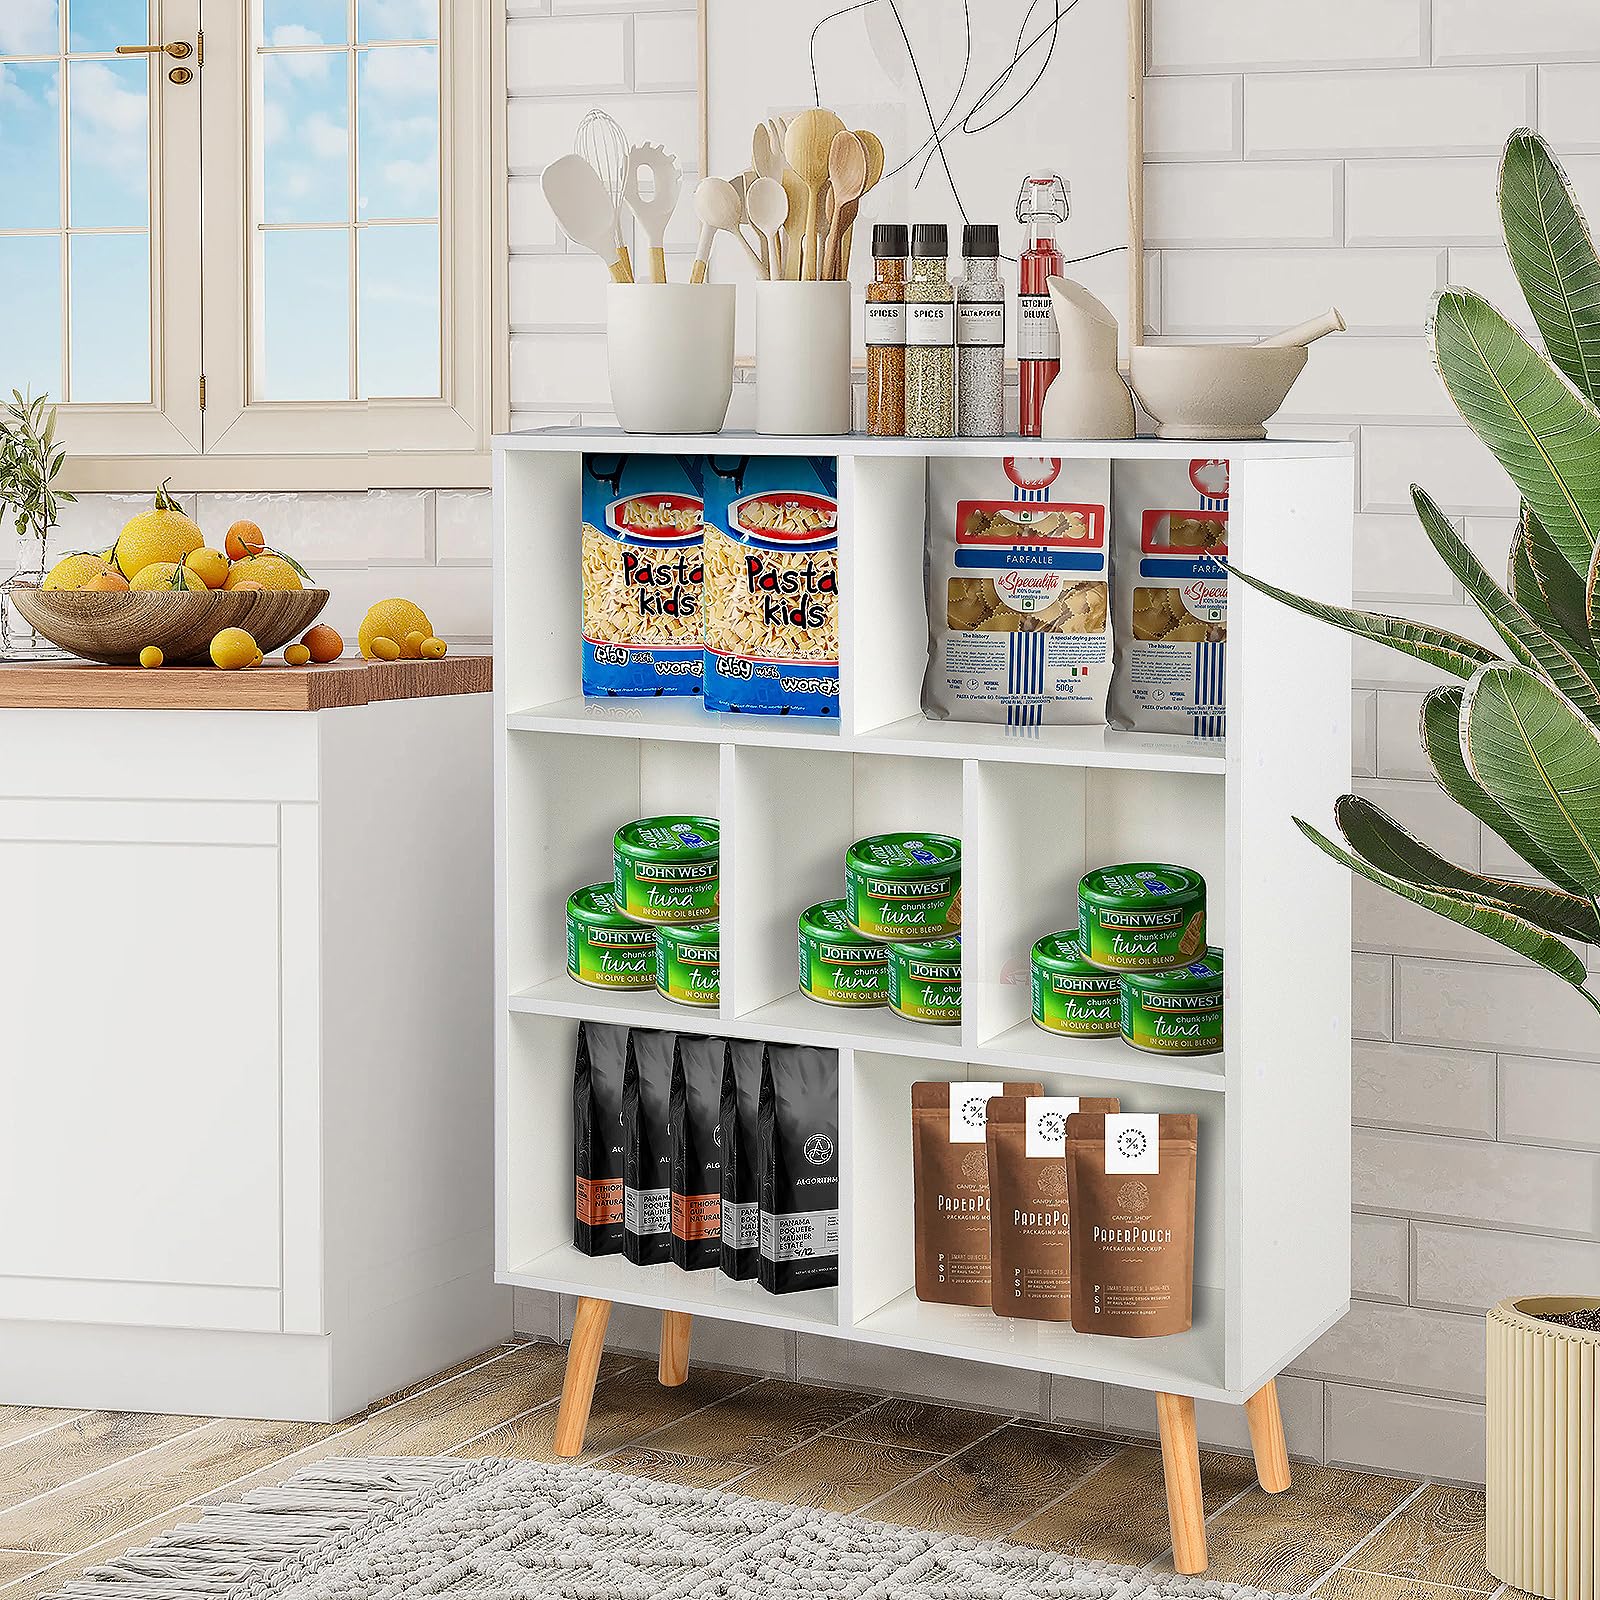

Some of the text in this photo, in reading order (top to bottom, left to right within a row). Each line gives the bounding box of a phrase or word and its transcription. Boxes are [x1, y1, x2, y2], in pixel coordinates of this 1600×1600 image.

[869, 309, 899, 318] SPICES
[913, 309, 944, 319] SPICES
[1023, 310, 1050, 319] DELUXE
[1006, 554, 1053, 565] FARFALLE
[744, 555, 839, 594] Pasta
[638, 586, 696, 617] kids
[763, 593, 826, 629] kids
[594, 644, 630, 667] play
[654, 660, 704, 678] word
[716, 655, 839, 697] play with words
[1055, 683, 1074, 693] 500g
[638, 863, 715, 879] JOHN WEST
[669, 885, 694, 894] chunk
[871, 881, 946, 896] JOHN WEST
[646, 886, 694, 907] tuna
[901, 901, 927, 911] chunk
[651, 909, 672, 918] OLIVE
[674, 909, 686, 918] OIL
[688, 907, 710, 917] BLEND
[878, 902, 926, 924] tuna
[1103, 911, 1178, 926] JOHN WEST
[884, 926, 904, 935] OLIVE
[906, 926, 918, 935] OIL
[920, 924, 943, 933] BLEND
[592, 930, 628, 943] JOHN
[1133, 931, 1158, 941] chunk
[1111, 933, 1159, 955] tuna
[621, 951, 647, 960] chunk
[825, 948, 861, 960] JOHN
[600, 950, 647, 973] tuna
[1116, 956, 1137, 964] OLIVE
[1139, 956, 1151, 965] OIL
[1152, 955, 1175, 964] BLEND
[854, 968, 879, 977] chunk
[913, 964, 950, 977] JOHN
[604, 974, 625, 983] OLIVE
[627, 975, 639, 983] OIL
[831, 967, 879, 989] tuna
[1056, 978, 1093, 991] JOHN
[694, 991, 714, 1000] OLIVE
[837, 991, 857, 1000] OLIVE
[859, 991, 871, 1000] OIL
[1086, 998, 1111, 1007] chunk
[1146, 994, 1221, 1008] JOHN WEST
[926, 1008, 946, 1017] OLIVE
[1065, 999, 1111, 1019] tuna
[1176, 1014, 1201, 1023] chunk
[1069, 1021, 1090, 1030] OLIVE
[1091, 1021, 1104, 1030] OIL
[1154, 1015, 1201, 1037] tuna
[1158, 1038, 1179, 1047] OLIVE
[1181, 1038, 1193, 1047] OIL
[1195, 1038, 1217, 1047] BLEND
[594, 1192, 611, 1200] GUJI
[689, 1208, 705, 1216] GUJI
[643, 1216, 667, 1224] ESTATE
[780, 1219, 811, 1228] PANAMA
[780, 1233, 813, 1242] MAUNIER
[1093, 1226, 1171, 1243] PAPERPOUCH
[780, 1241, 804, 1250] ESTATE
